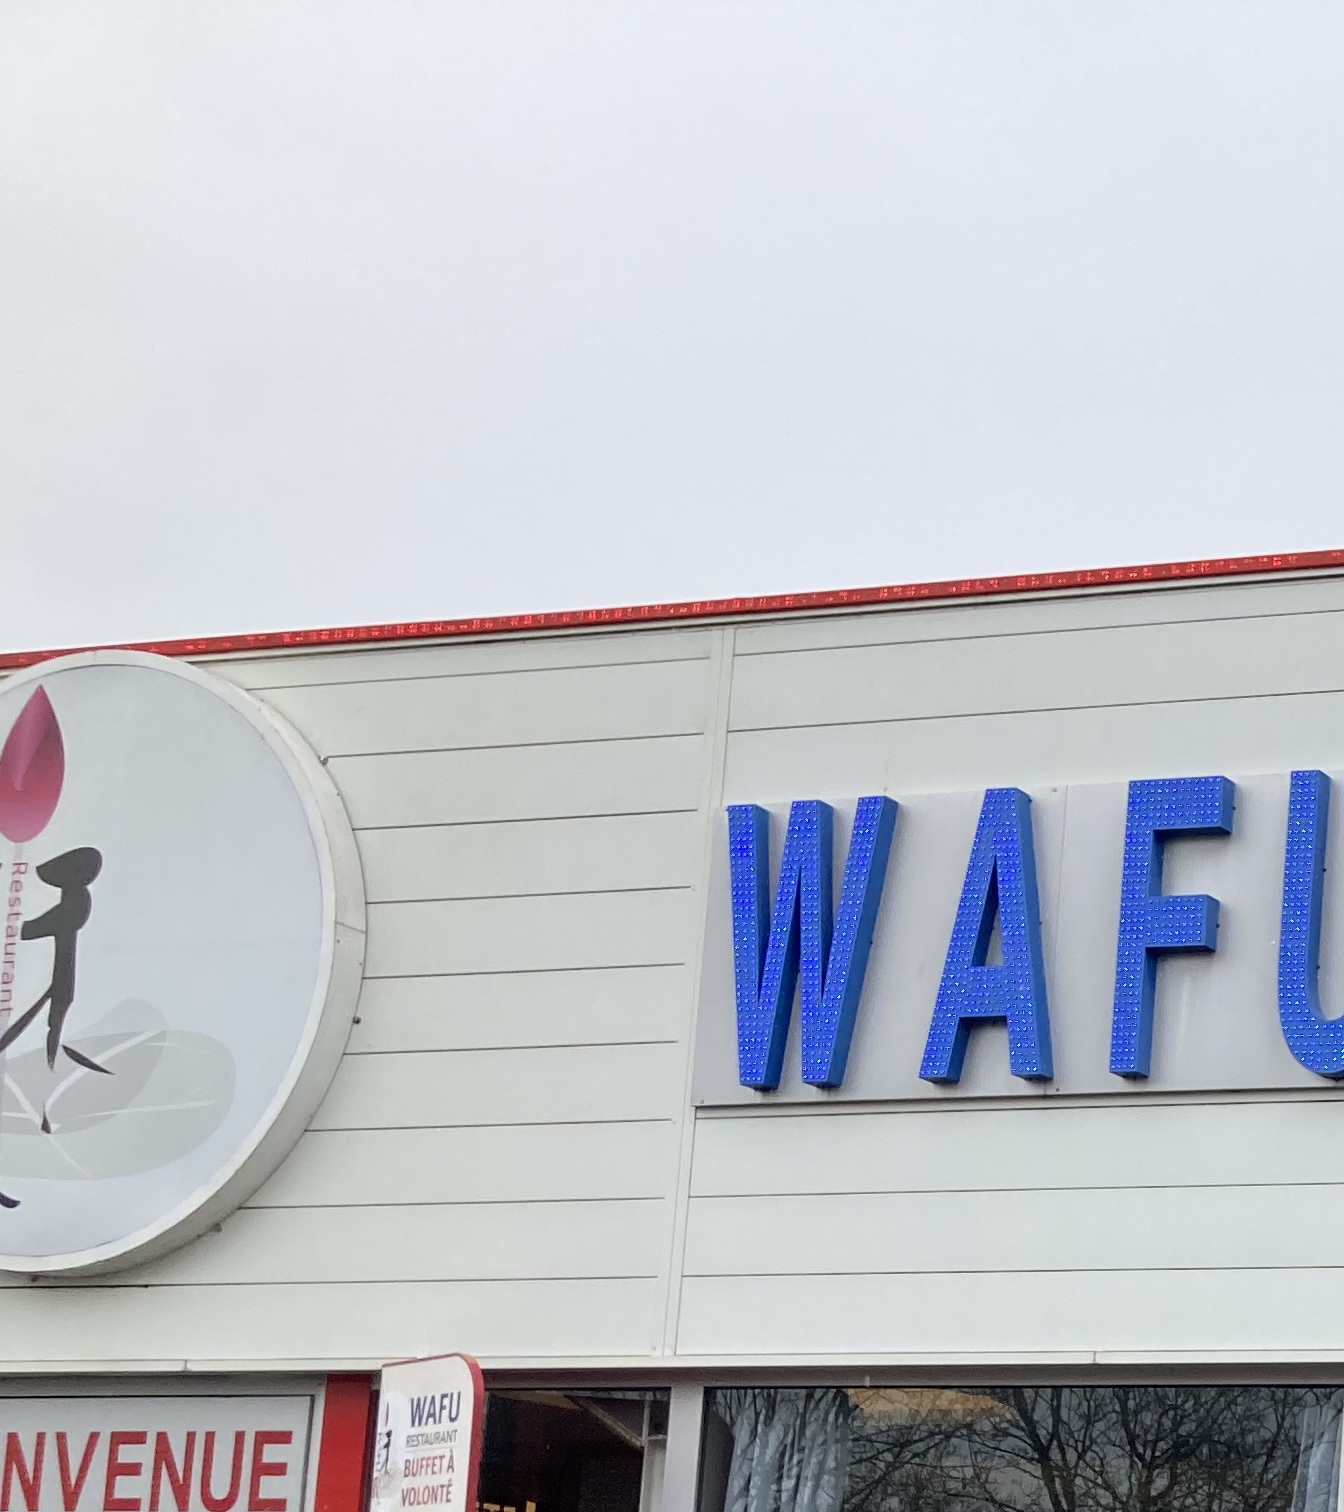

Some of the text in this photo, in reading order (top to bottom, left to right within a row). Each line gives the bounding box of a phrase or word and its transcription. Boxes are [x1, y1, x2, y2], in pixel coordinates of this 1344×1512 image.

[0, 861, 28, 1018] Restaurant
[410, 1391, 461, 1428] WAFU
[405, 1430, 458, 1448] RESTAURANT
[0, 1430, 293, 1512] NVENUE
[404, 1455, 446, 1478] BUFFET
[401, 1477, 453, 1507] VOLONTÉ
